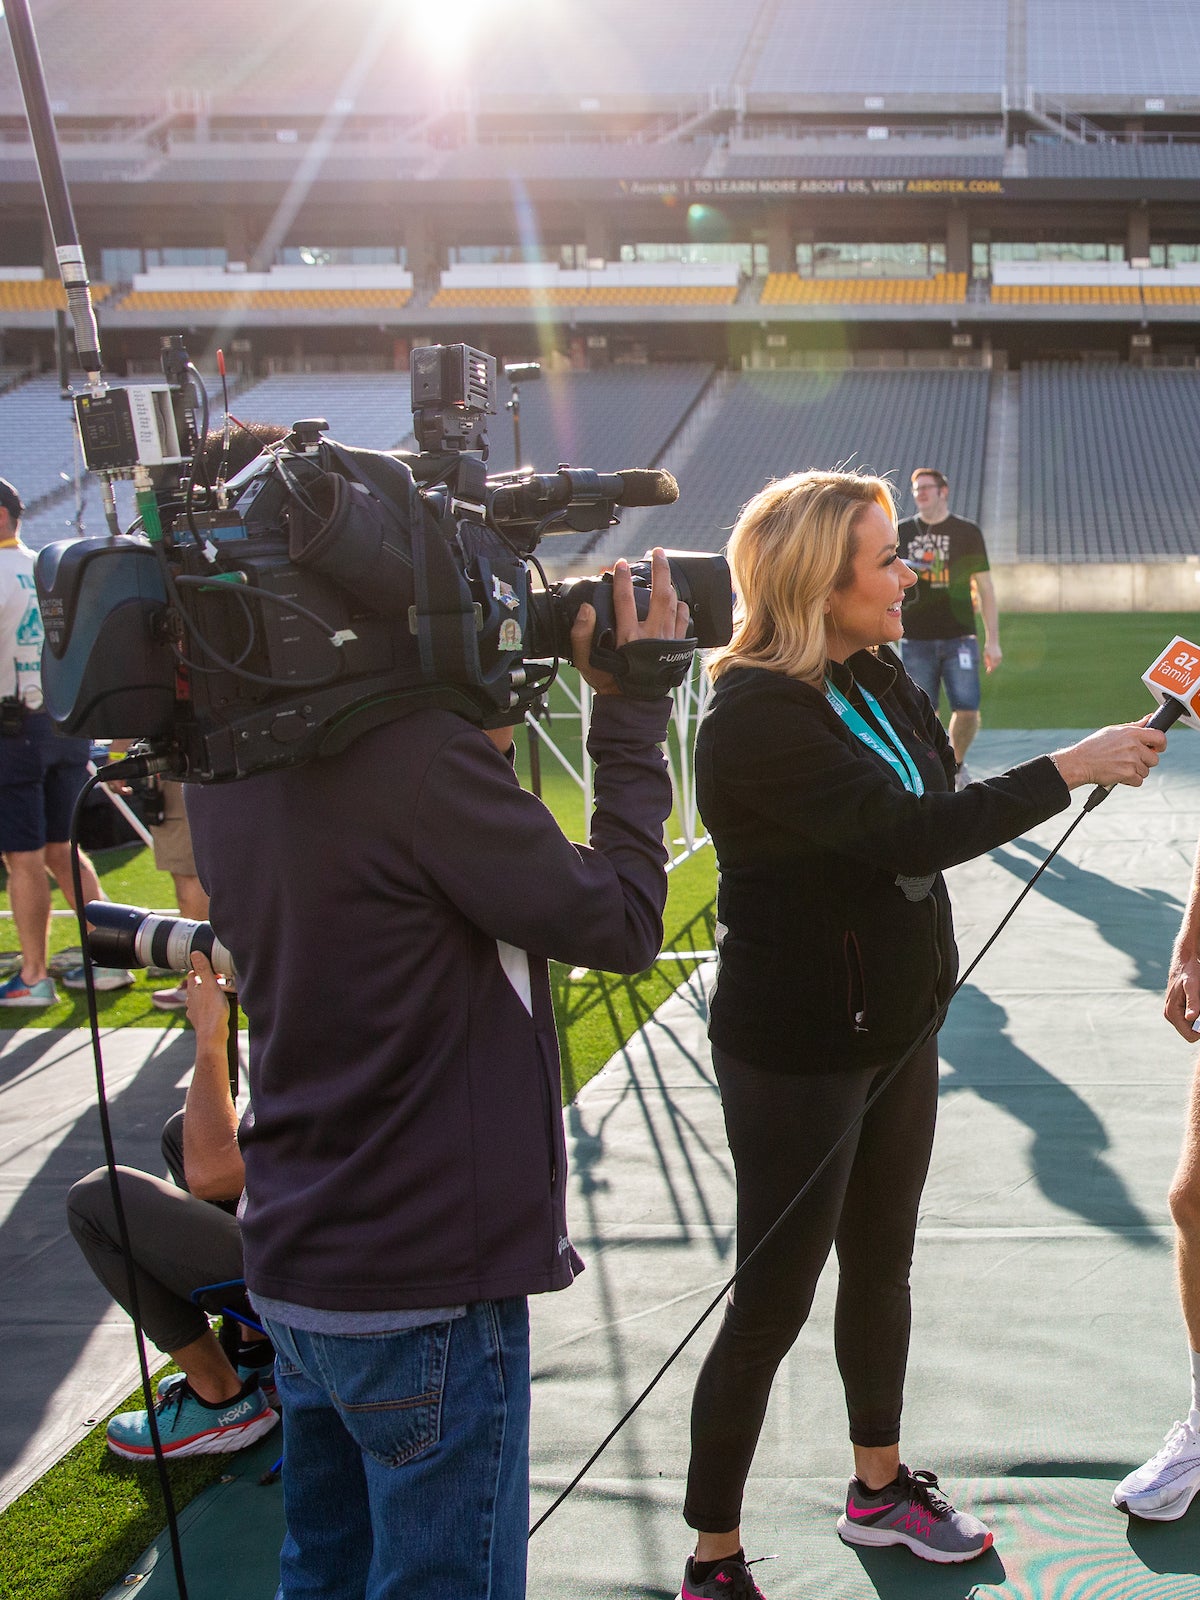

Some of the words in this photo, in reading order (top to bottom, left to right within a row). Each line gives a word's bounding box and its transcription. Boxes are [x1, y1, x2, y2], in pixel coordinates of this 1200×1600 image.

[695, 180, 713, 193] TO
[714, 180, 757, 193] LEARN
[759, 180, 797, 193] MORE
[800, 180, 845, 193] ABOUT
[847, 180, 870, 195] US,
[872, 180, 905, 193] VISIT
[1174, 652, 1199, 671] az
[1157, 660, 1195, 688] family
[217, 1401, 252, 1427] HOKA
